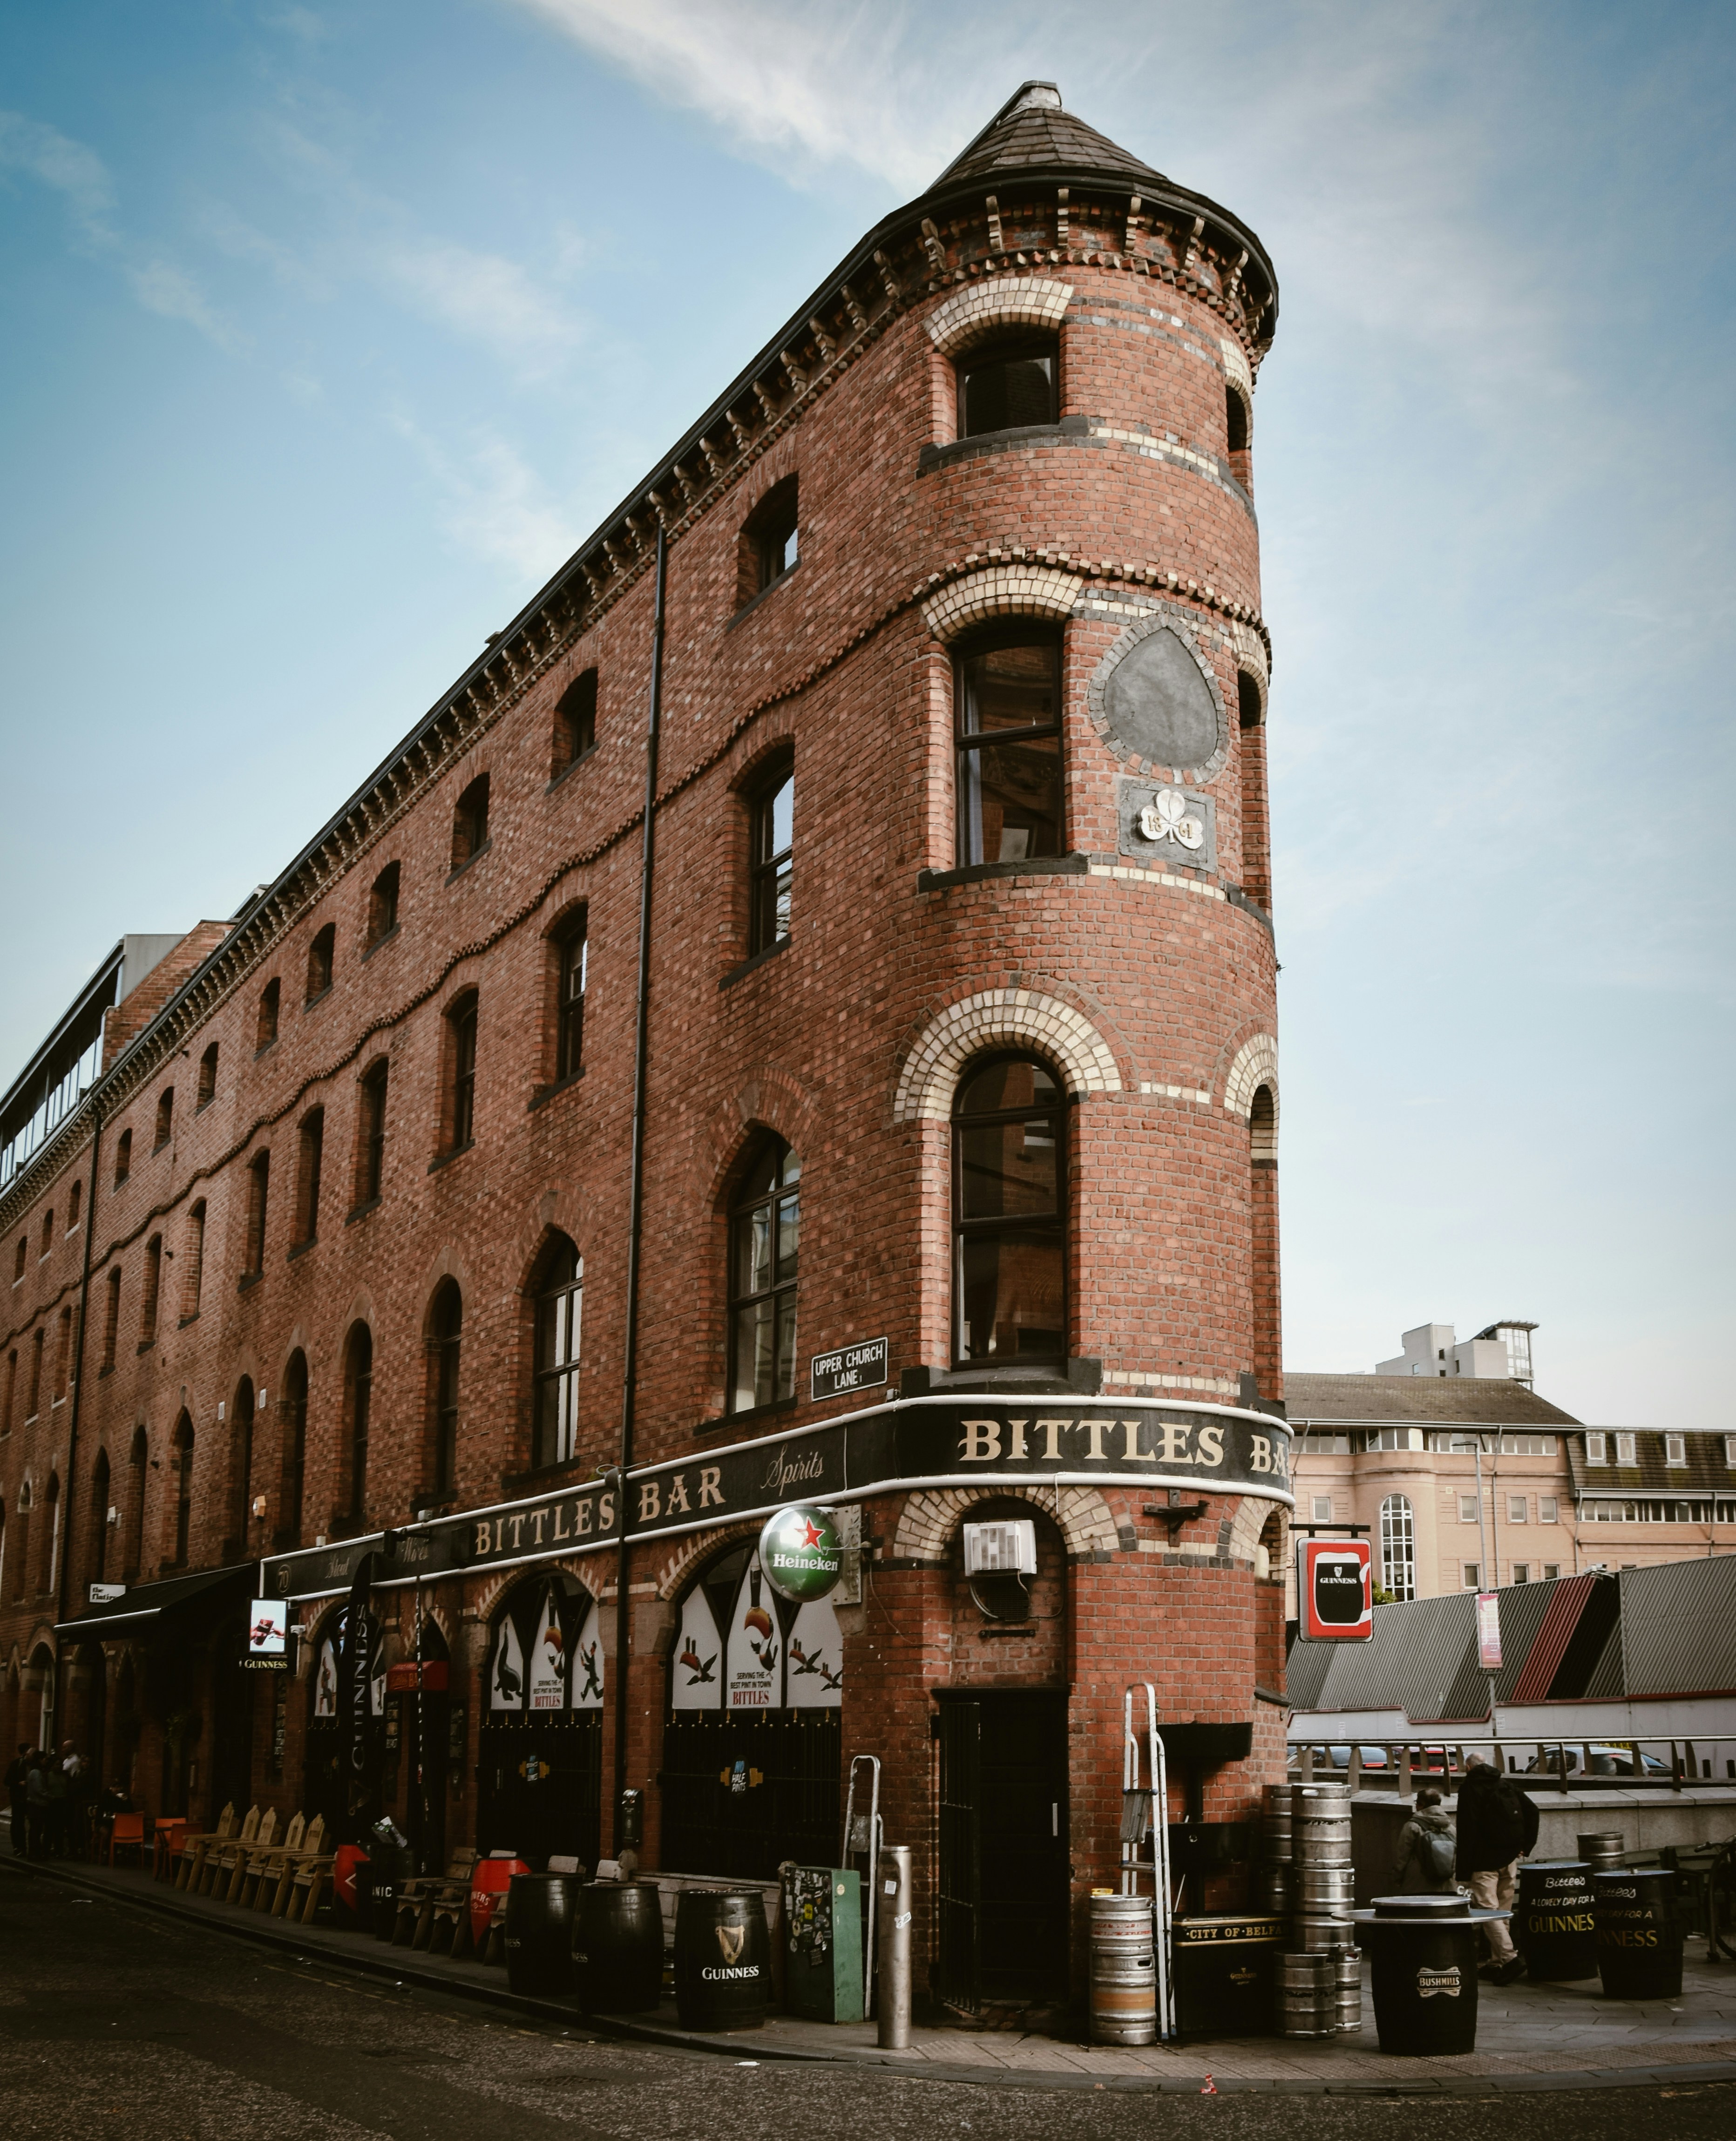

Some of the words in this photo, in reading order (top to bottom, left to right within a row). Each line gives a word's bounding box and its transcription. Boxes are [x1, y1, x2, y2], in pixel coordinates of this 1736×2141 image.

[1148, 815, 1163, 832] 18
[1179, 822, 1192, 839] 61
[815, 1355, 842, 1376] UPPER
[846, 1344, 883, 1368] CHURCH
[834, 1369, 858, 1389] LANE
[958, 1420, 1225, 1467] BITTLES
[1250, 1435, 1288, 1477] BA
[760, 1443, 825, 1497] Spirits
[475, 1492, 615, 1556] BITTLES
[637, 1466, 726, 1523] BAR
[773, 1553, 838, 1572] Heineken
[279, 1570, 289, 1588] 70
[244, 1659, 287, 1669] GUINNESS
[351, 1604, 368, 1770] GUINNESS
[535, 1695, 561, 1707] BITTLES
[733, 1690, 769, 1705] BITTLES
[1537, 1897, 1562, 1907] LOVELY
[1562, 1897, 1577, 1906] DAY
[1577, 1895, 1590, 1904] FOR
[1529, 1912, 1595, 1933] GUINNES
[1624, 1910, 1642, 1918] FOR
[1644, 1910, 1653, 1919] A
[1190, 1929, 1218, 1939] CITY
[1225, 1927, 1241, 1938] OF
[702, 1965, 760, 1980] GUINNESS
[1419, 1977, 1460, 1986] BUSHMILLS
